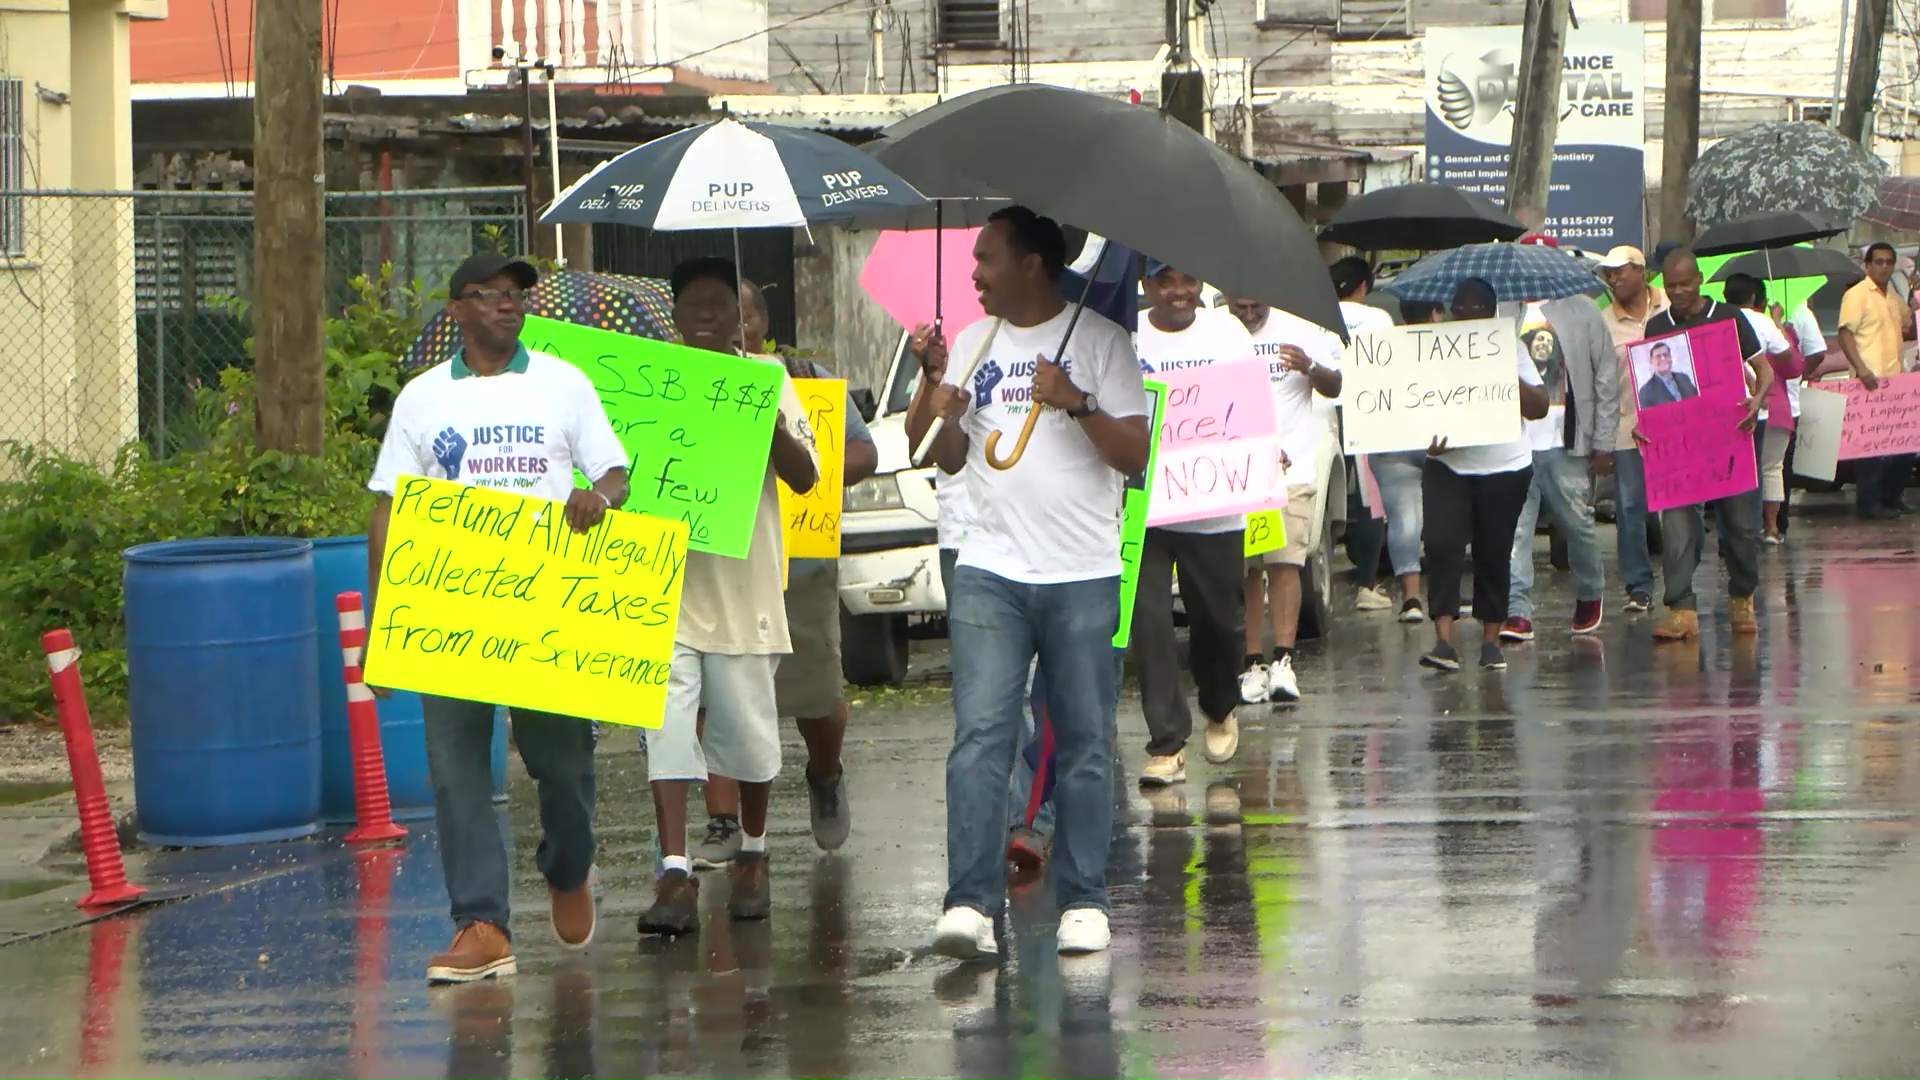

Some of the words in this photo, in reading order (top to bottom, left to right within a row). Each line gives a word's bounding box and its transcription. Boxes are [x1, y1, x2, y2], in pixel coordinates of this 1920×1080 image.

[1477, 73, 1633, 100] DETAL
[1580, 104, 1633, 117] CARE
[1444, 155, 1482, 163] General
[1484, 154, 1501, 162] and
[821, 170, 863, 189] PUP
[1445, 170, 1475, 178] Dental
[708, 183, 754, 197] PUP
[821, 184, 889, 207] DELIVERS
[1483, 184, 1505, 192] Reta
[579, 199, 644, 210] DELIERS
[692, 200, 771, 213] DELIVERS
[1561, 217, 1614, 225] 615-0707
[1561, 229, 1614, 237] 203-1133
[1253, 343, 1280, 356] STIC
[1355, 333, 1393, 367] NO
[1406, 330, 1501, 363] TAXES
[594, 354, 687, 401] SSB
[1356, 388, 1392, 414] ON
[1404, 382, 1518, 410] Severance
[1160, 402, 1242, 443] nce!
[472, 425, 545, 446] JUSTICE
[669, 427, 697, 448] a
[468, 456, 549, 474] WORKERS
[494, 478, 509, 487] WE
[1165, 453, 1251, 500] NOW
[396, 478, 525, 542] Refund
[386, 540, 545, 602] Collected
[561, 576, 670, 626] Taxes
[380, 605, 474, 657] from
[482, 635, 530, 664] our
[530, 630, 671, 686] Severance
